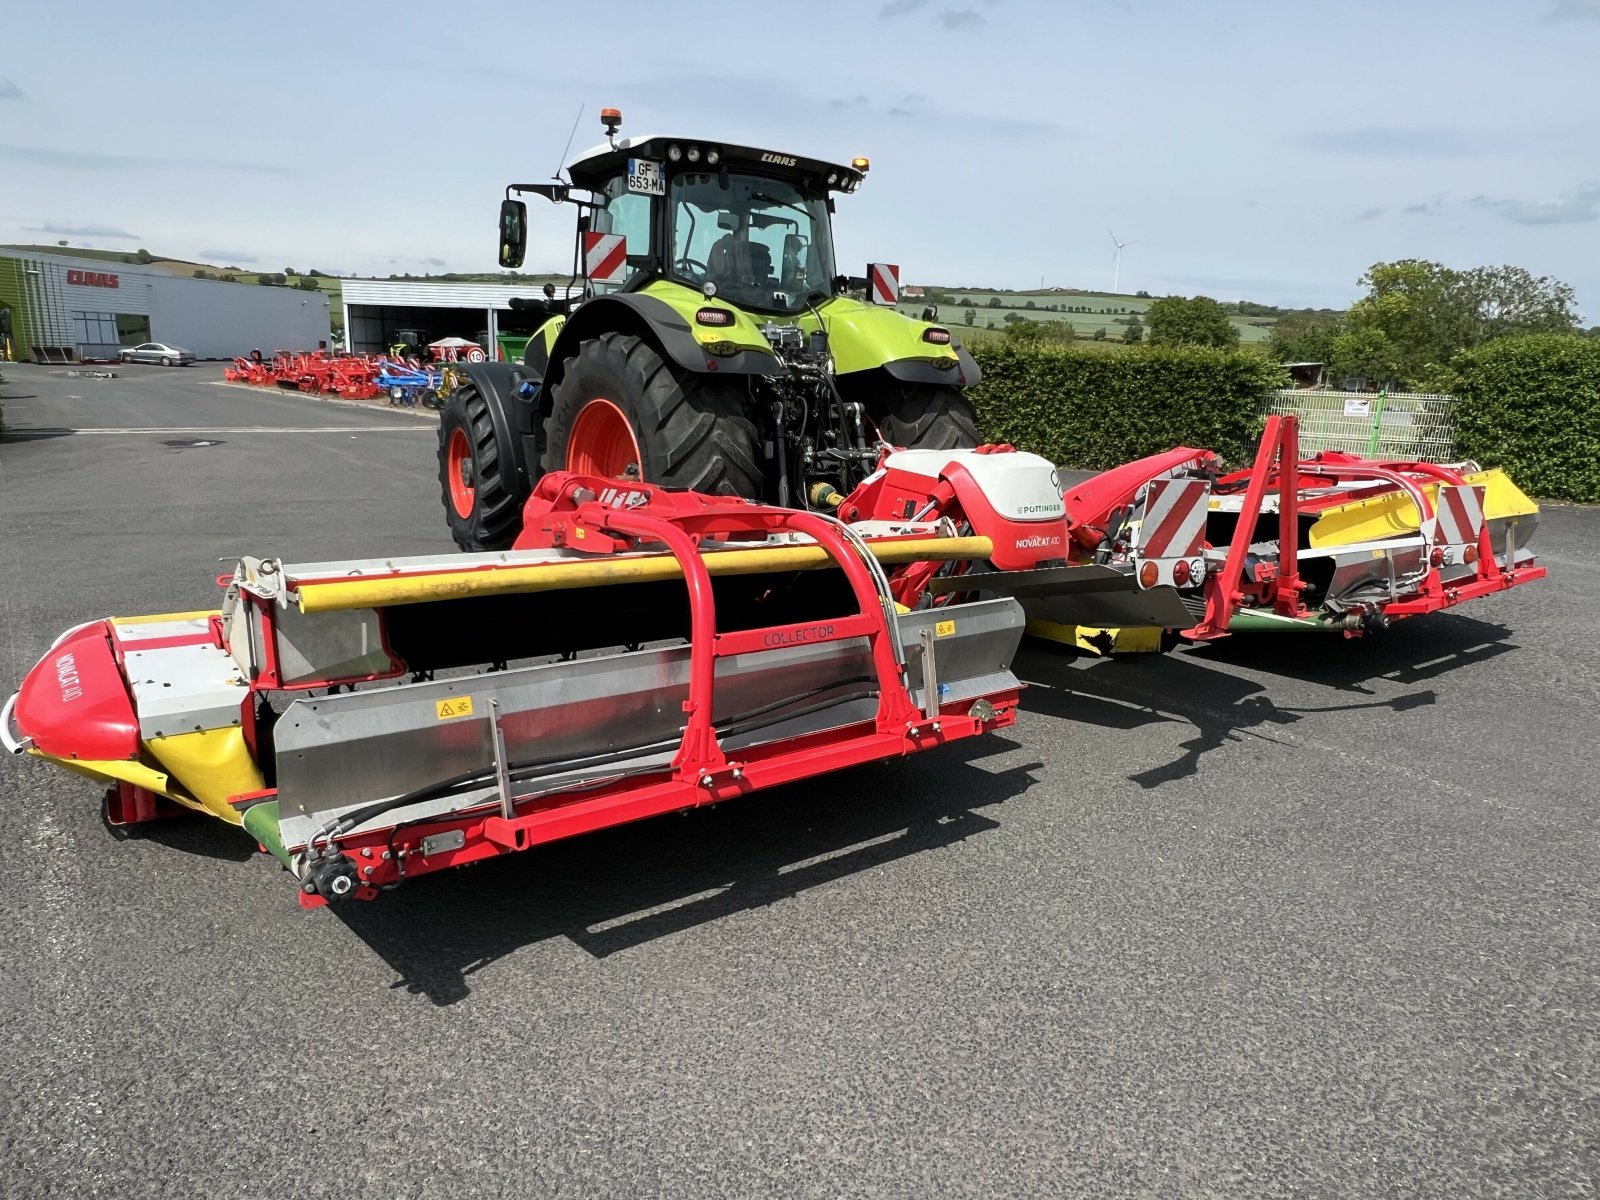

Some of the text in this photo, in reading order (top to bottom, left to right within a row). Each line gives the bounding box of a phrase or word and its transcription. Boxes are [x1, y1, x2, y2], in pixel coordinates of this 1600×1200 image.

[761, 153, 797, 167] CLAAS
[629, 175, 664, 193] 653-MA
[66, 269, 120, 289] CLAAS
[471, 353, 482, 361] 10
[1015, 537, 1050, 549] NOVACAT
[764, 625, 834, 647] COLLECTOR
[55, 652, 80, 689] NOVACAT
